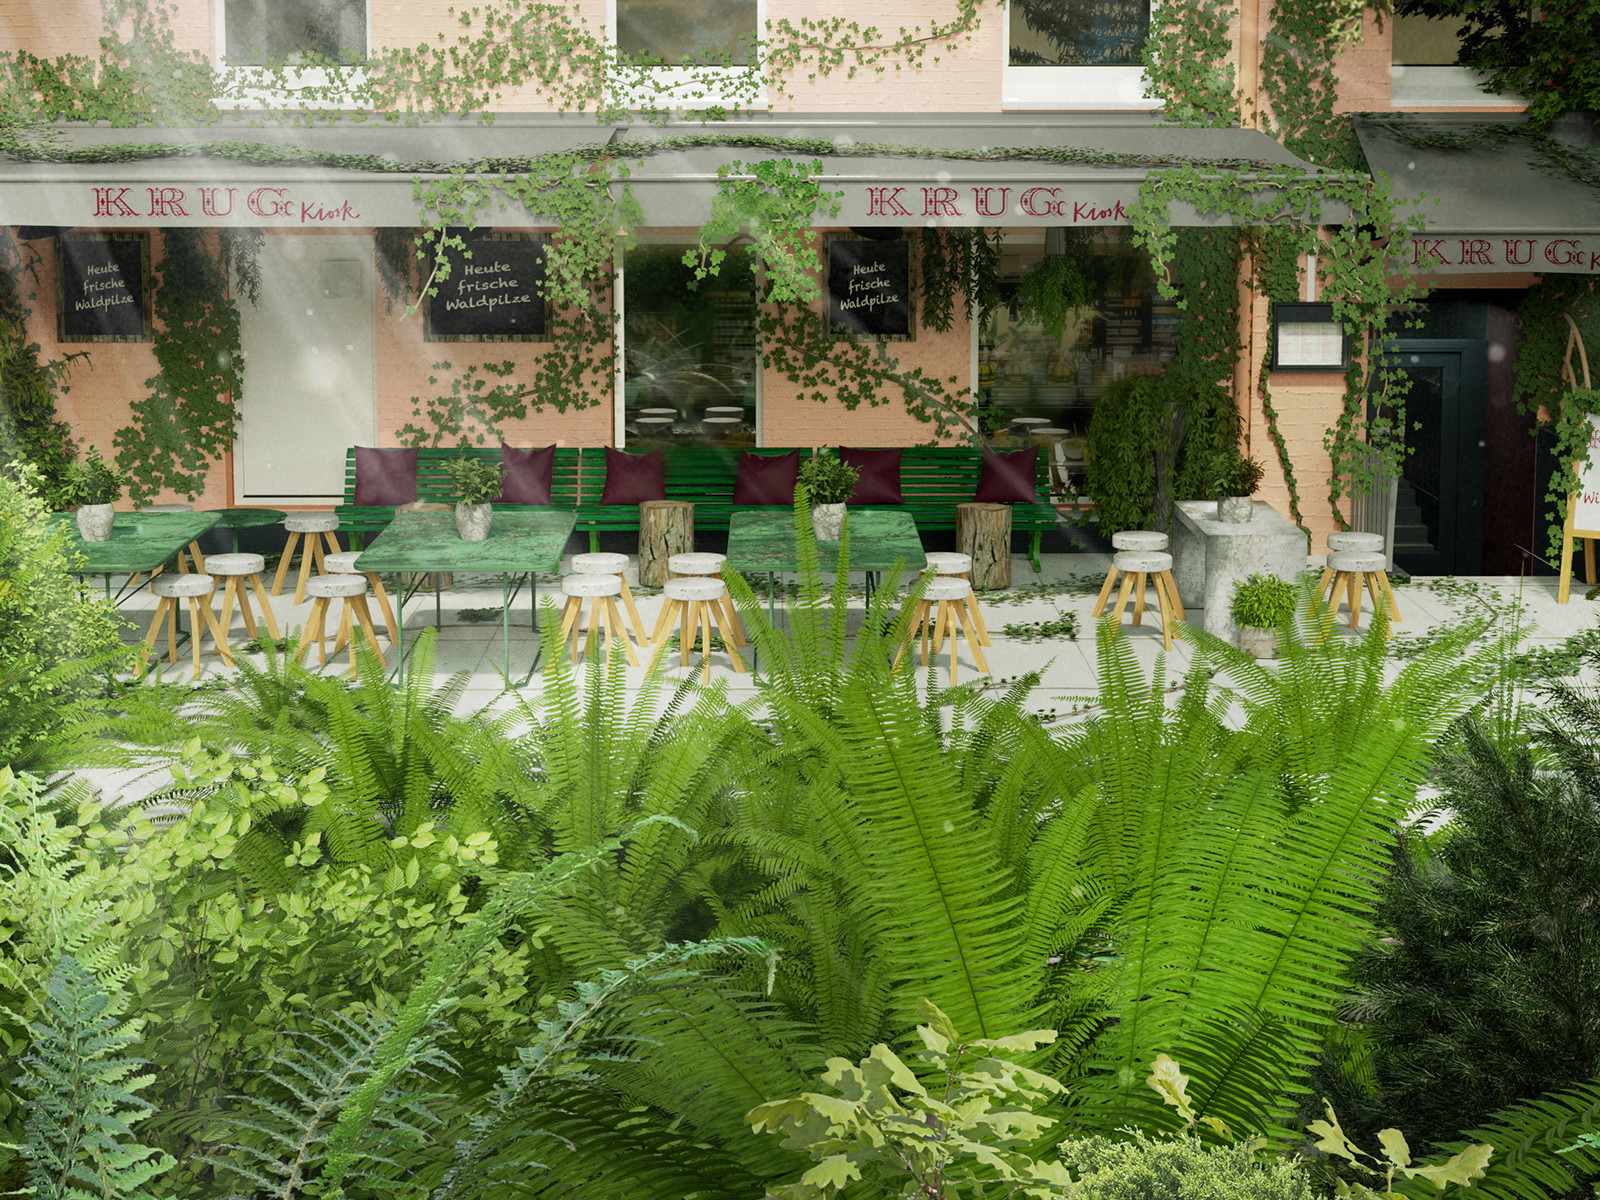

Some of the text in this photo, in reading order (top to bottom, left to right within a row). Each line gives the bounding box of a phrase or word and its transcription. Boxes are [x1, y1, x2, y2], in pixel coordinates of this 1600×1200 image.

[91, 187, 361, 223] KRUG Kiosk
[865, 187, 1129, 223] KRUG Kiosk
[1410, 239, 1587, 267] KRUG
[87, 261, 120, 276] Heute
[464, 261, 511, 276] Heute
[853, 261, 886, 276] Heute
[83, 277, 125, 296] frische
[457, 277, 519, 296] frische
[848, 277, 891, 296] frische
[75, 293, 135, 313] Waldpilze
[445, 293, 531, 312] Waldpilze
[840, 293, 899, 312] Waldpilze
